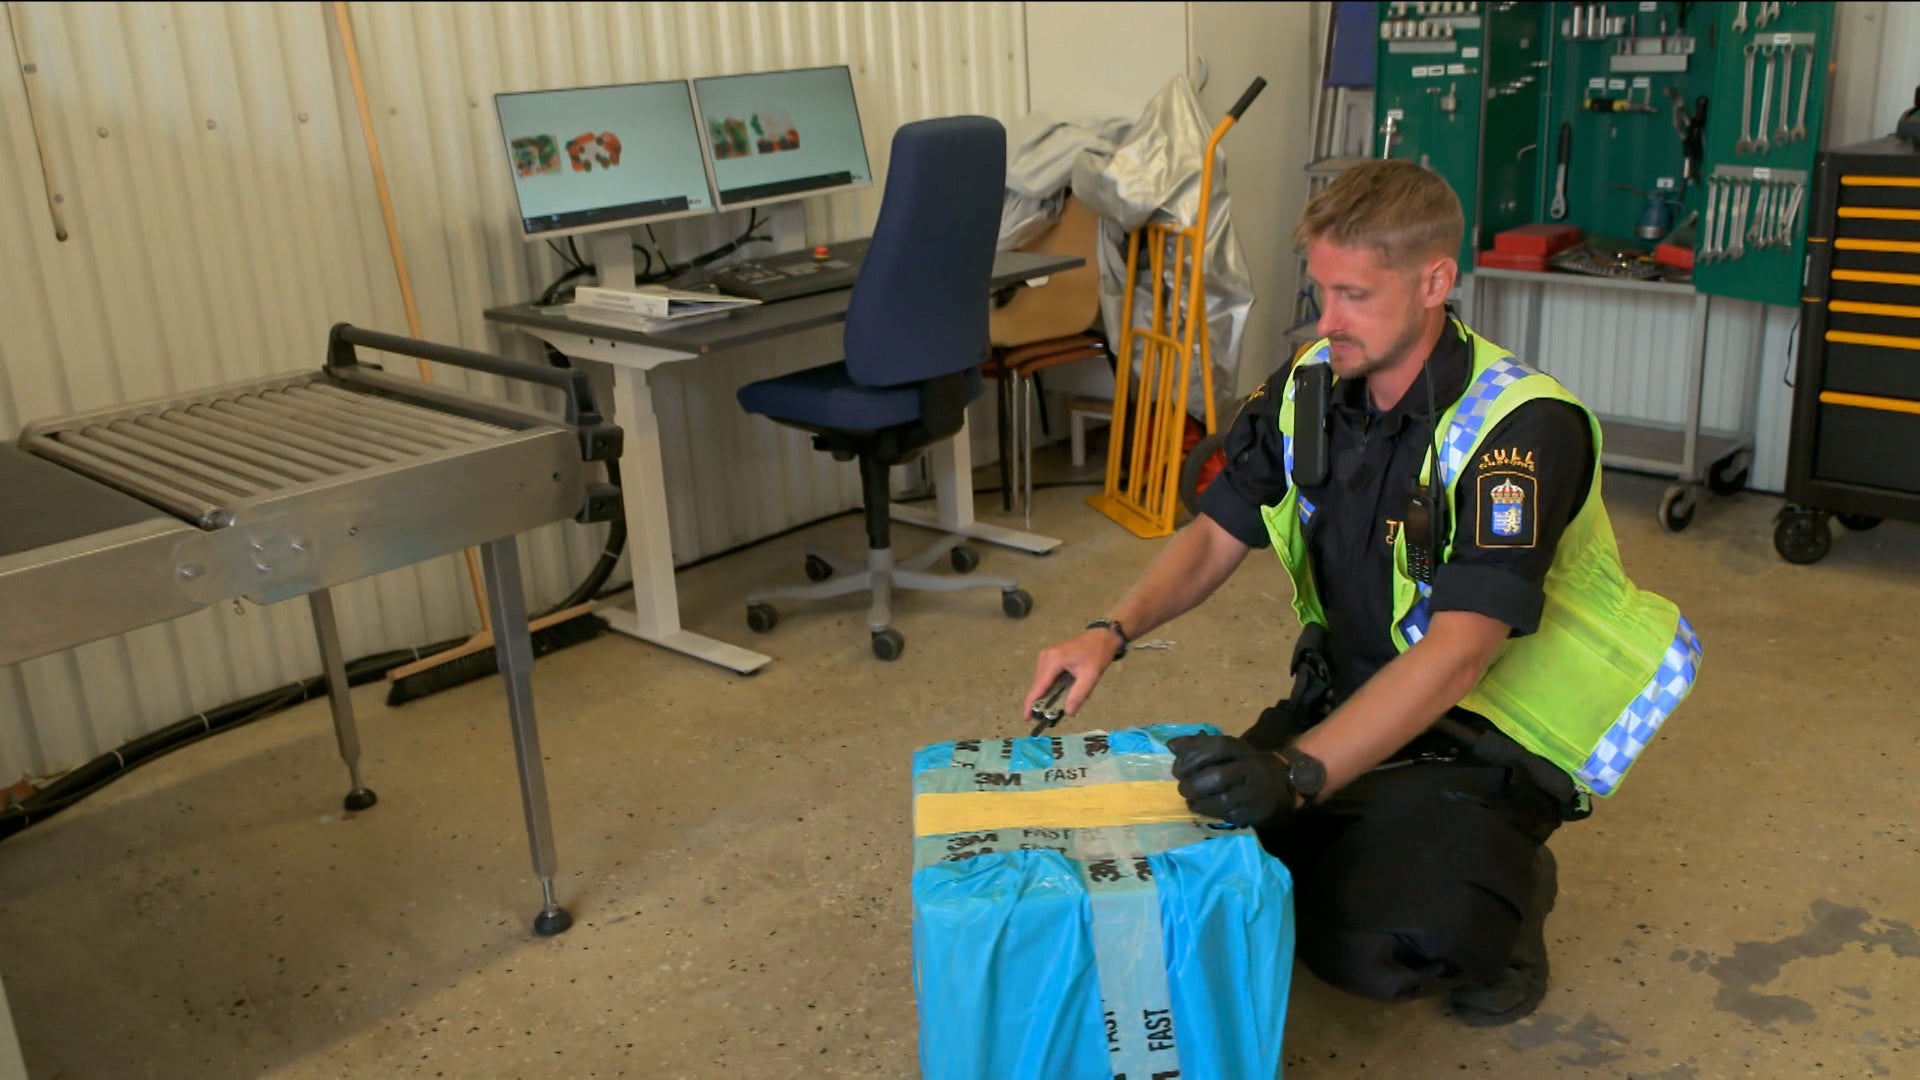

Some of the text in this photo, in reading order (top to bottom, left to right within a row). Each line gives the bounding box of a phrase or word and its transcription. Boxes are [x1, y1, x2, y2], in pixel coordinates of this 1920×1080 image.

[1482, 447, 1534, 465] TULL
[975, 767, 1089, 786] 3M FAST
[1143, 1009, 1175, 1052] FAST
